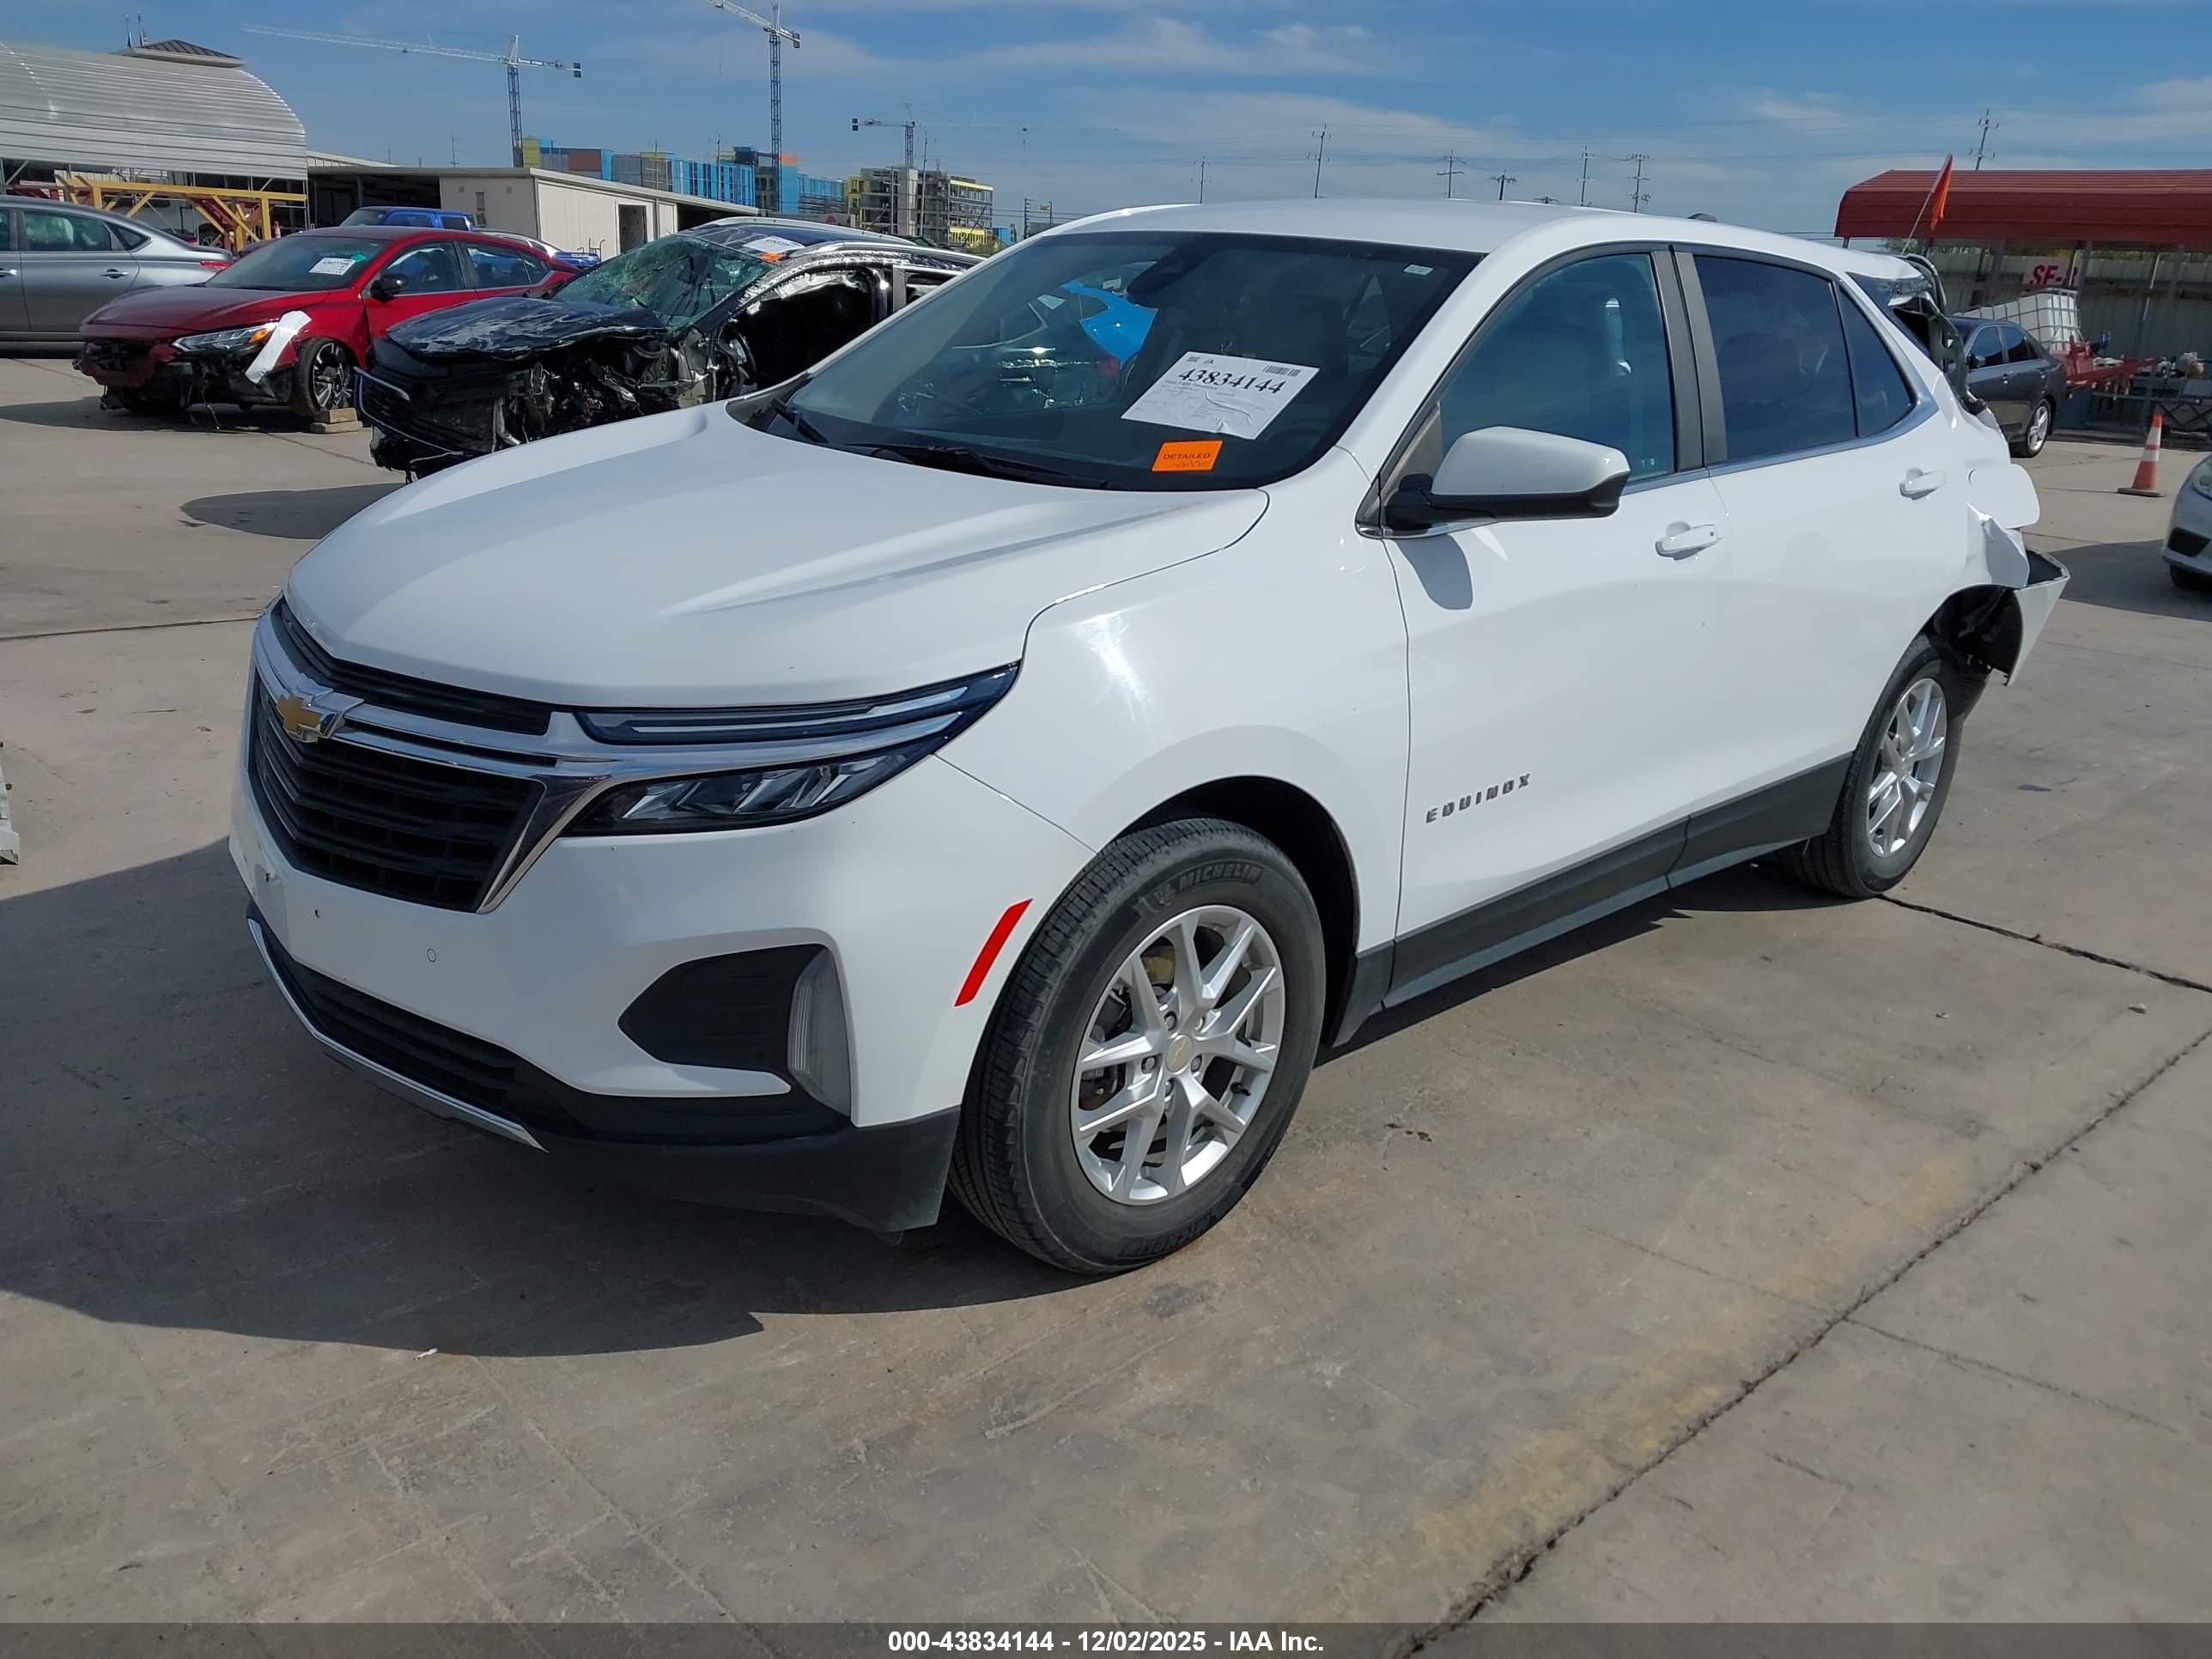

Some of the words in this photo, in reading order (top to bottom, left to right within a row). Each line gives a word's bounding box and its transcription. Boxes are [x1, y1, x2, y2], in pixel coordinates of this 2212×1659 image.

[1178, 368, 1287, 394] 43834144
[1425, 773, 1530, 823] EQUINOX
[1179, 862, 1262, 891] MICHELIN
